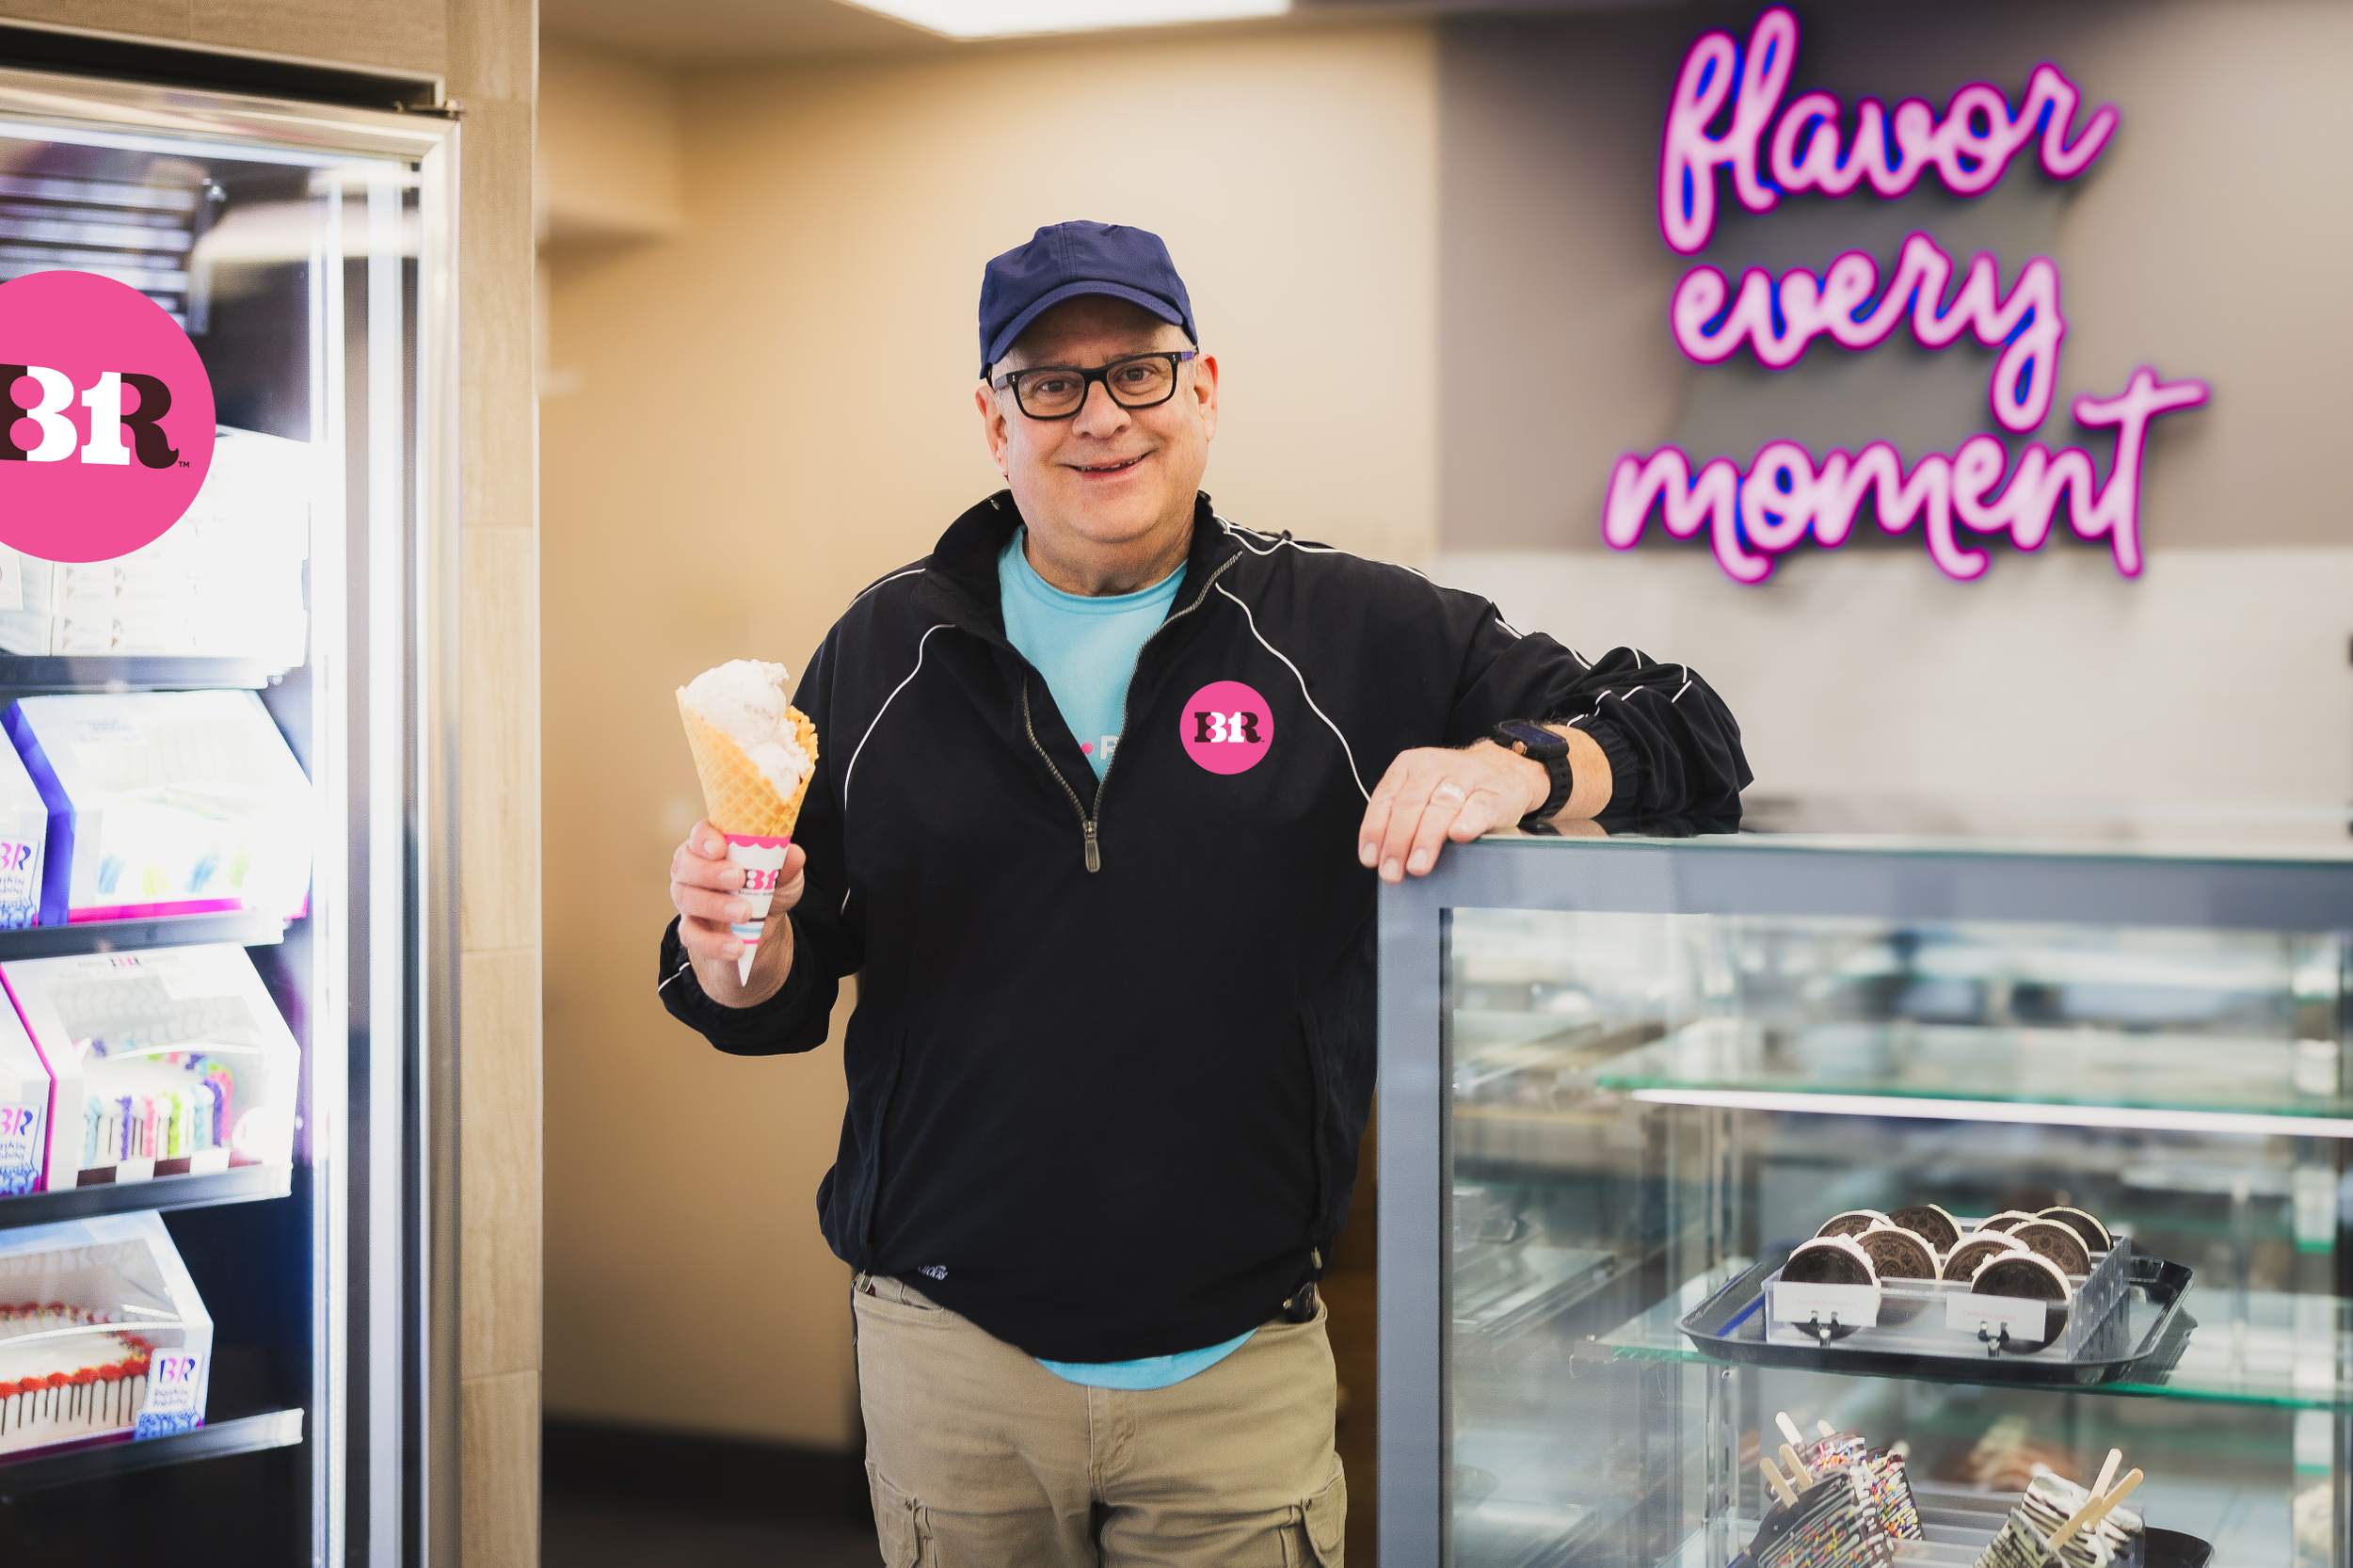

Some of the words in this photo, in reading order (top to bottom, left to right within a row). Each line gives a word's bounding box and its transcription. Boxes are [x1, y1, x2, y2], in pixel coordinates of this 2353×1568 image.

[1659, 5, 2121, 255] flavor
[1672, 231, 2066, 434] every
[1604, 364, 2210, 584] moment
[1194, 712, 1262, 744] BR
